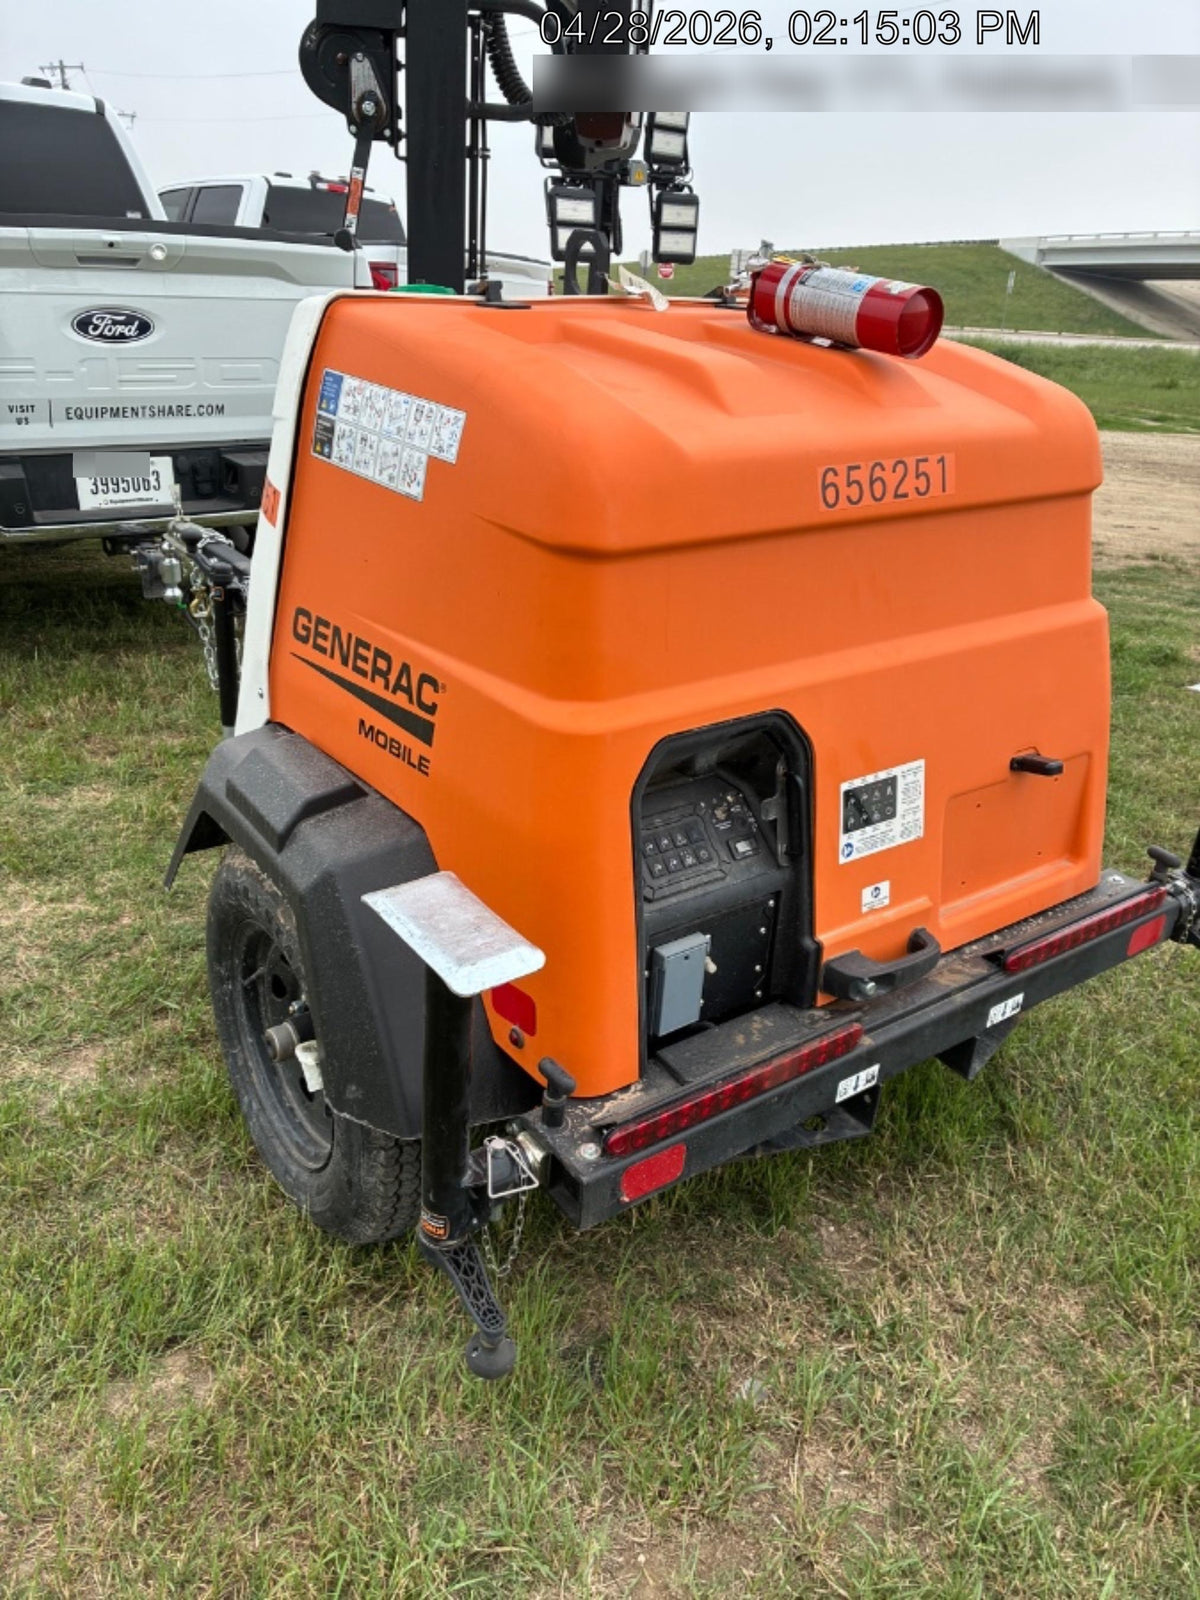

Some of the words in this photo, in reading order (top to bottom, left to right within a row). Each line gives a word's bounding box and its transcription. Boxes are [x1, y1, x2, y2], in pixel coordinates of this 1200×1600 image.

[88, 314, 140, 337] Ford
[8, 404, 36, 414] VISIT
[65, 403, 226, 421] EQUIPMENTSHARE.COM
[15, 416, 30, 426] US
[821, 455, 947, 509] 656251
[292, 606, 440, 717] GENERAC
[358, 718, 431, 778] MOBILE
